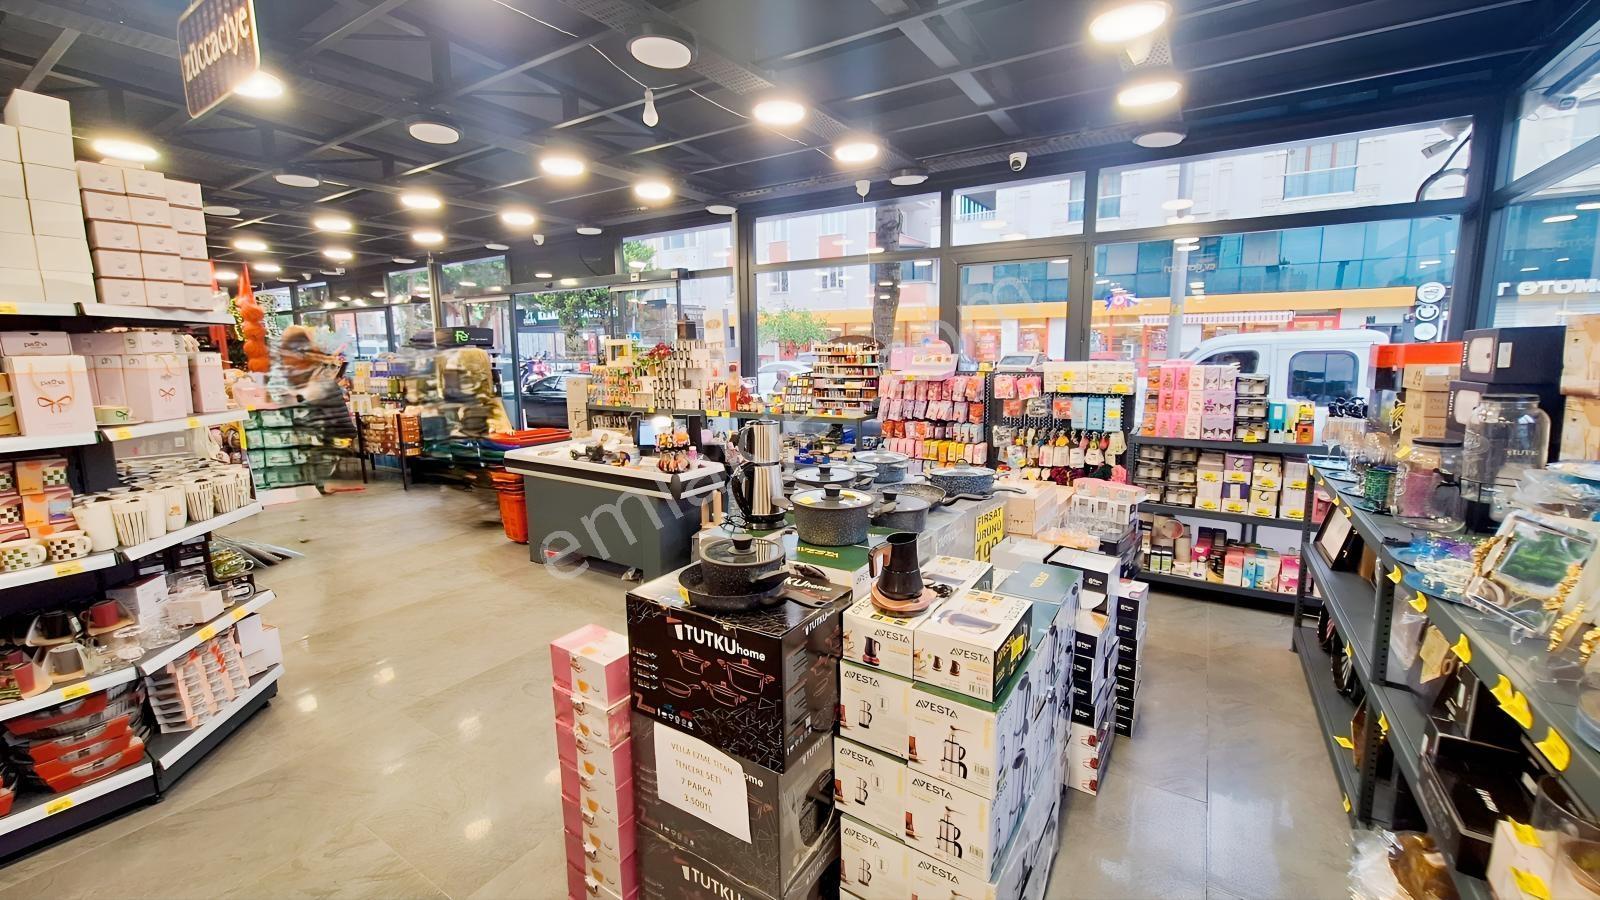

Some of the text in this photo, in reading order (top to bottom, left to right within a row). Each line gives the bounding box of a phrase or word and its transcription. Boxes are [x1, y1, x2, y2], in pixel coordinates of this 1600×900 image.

[977, 506, 1002, 527] FIRSAT
[874, 628, 910, 644] AVESTA
[949, 647, 990, 665] AVESTA
[843, 670, 880, 688] AVESTA
[915, 699, 959, 719] AVESTA
[839, 747, 875, 768] AVESTA
[687, 780, 713, 797] PARÇA
[912, 778, 953, 801] AVESTA
[843, 827, 880, 849] AVESTA
[917, 860, 960, 885] AVESTA
